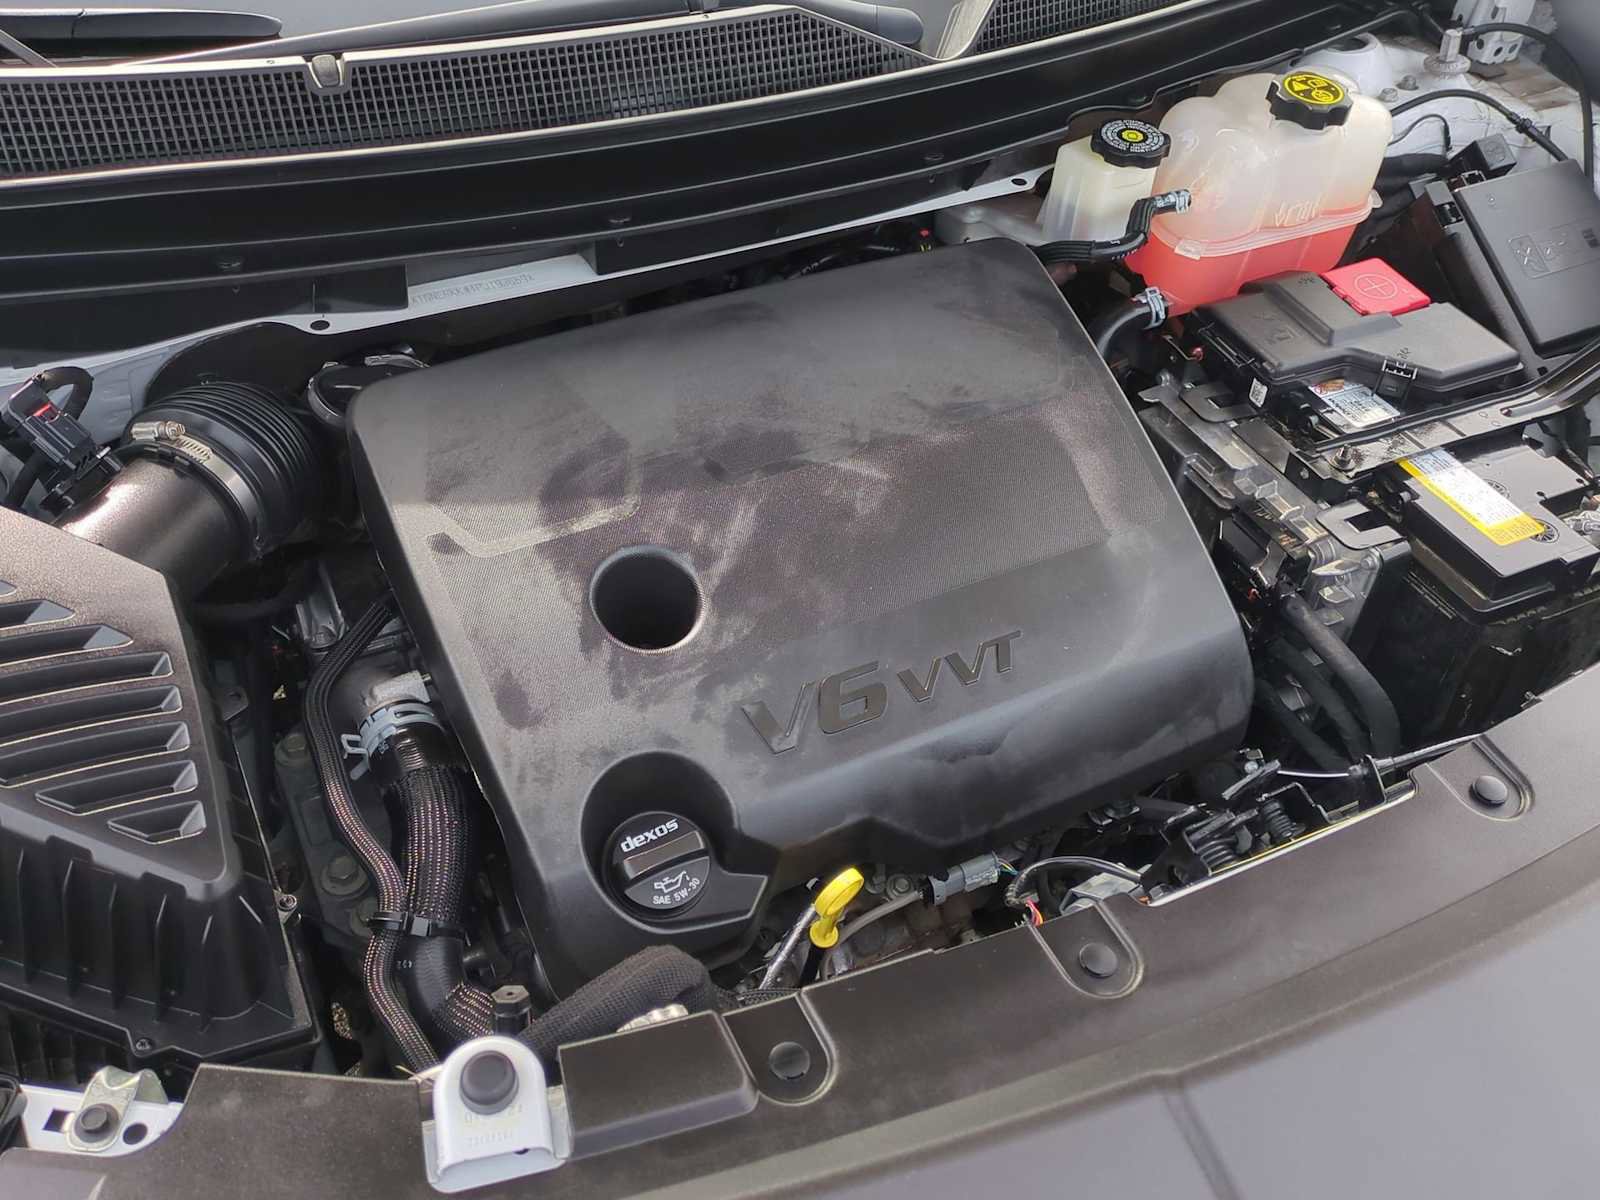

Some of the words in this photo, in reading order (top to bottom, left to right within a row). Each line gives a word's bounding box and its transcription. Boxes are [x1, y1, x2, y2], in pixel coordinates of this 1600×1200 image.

[740, 661, 888, 755] V6
[897, 630, 1022, 702] VVT
[621, 819, 679, 852] dexos
[653, 895, 671, 905] SAE
[674, 878, 700, 901] 5W-30
